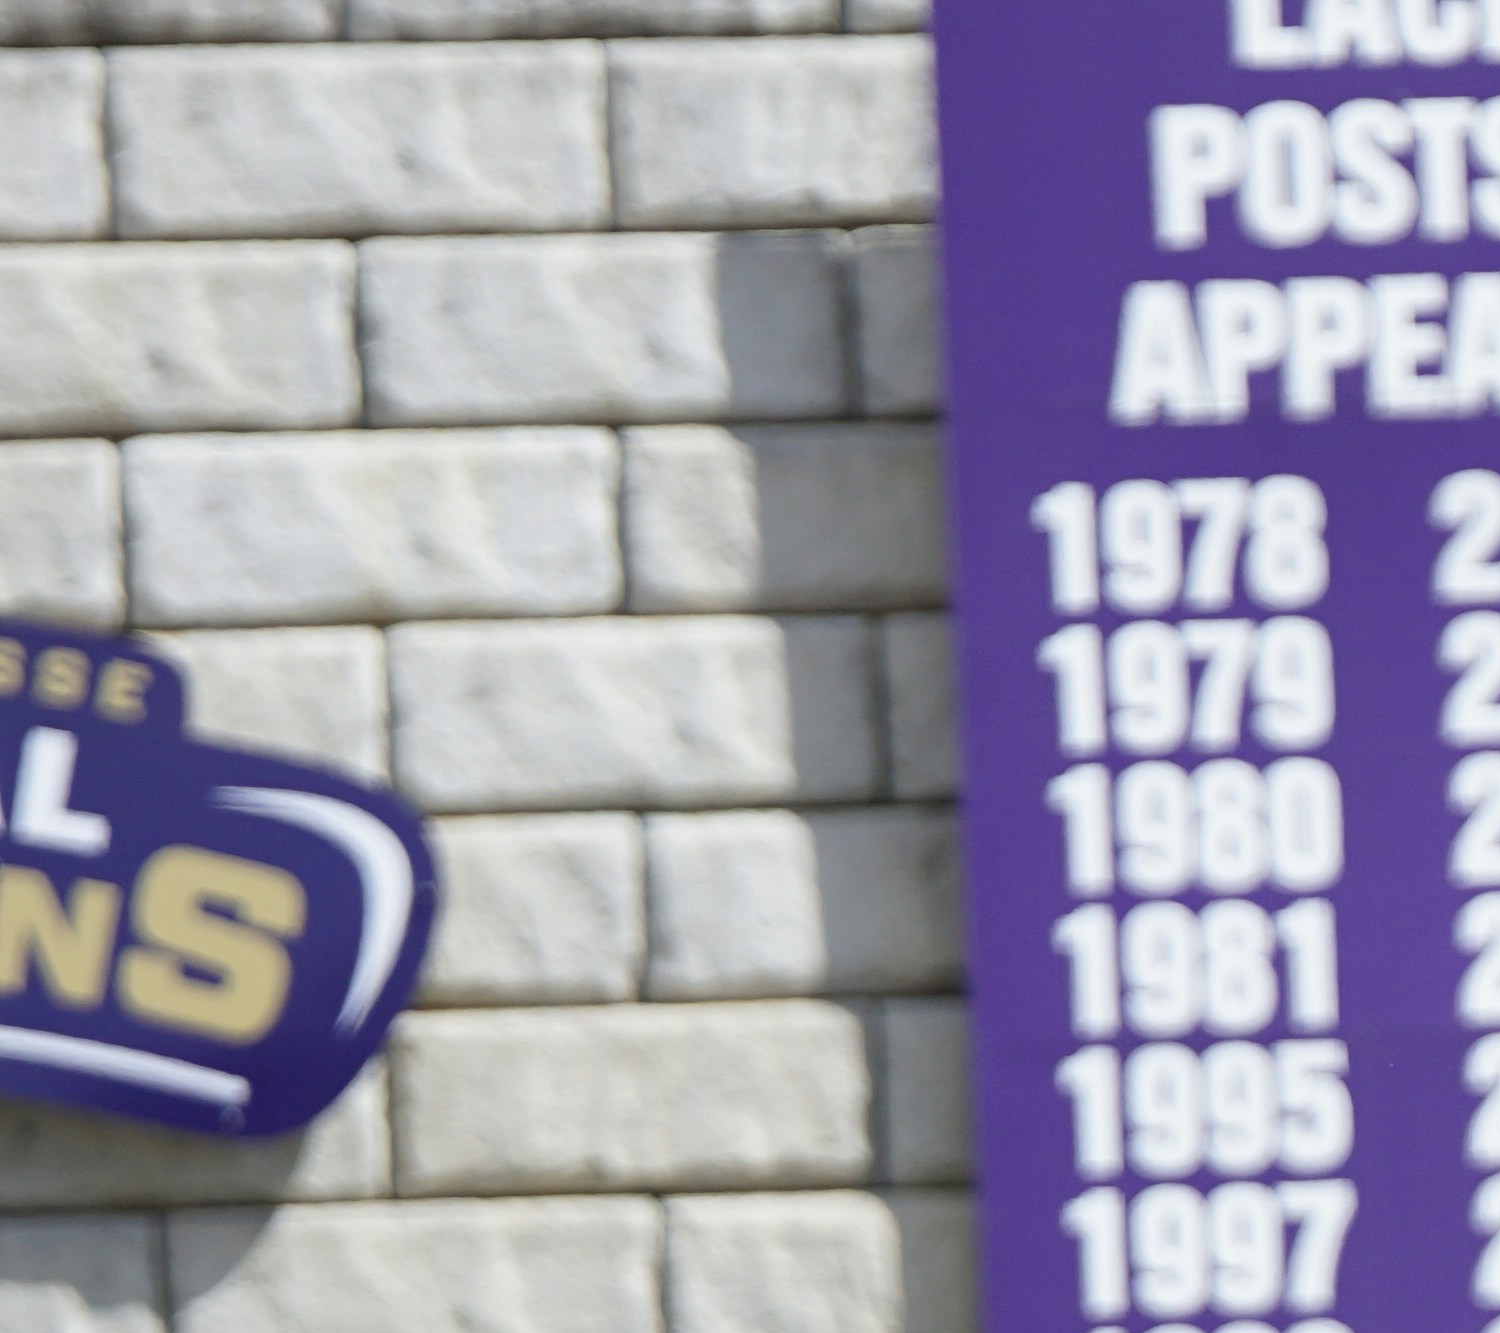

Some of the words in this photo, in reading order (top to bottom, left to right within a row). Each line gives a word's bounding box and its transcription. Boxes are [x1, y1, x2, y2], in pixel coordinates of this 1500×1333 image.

[1033, 475, 1329, 613] 1978
[1039, 616, 1335, 755] 1979
[0, 725, 112, 858] L
[1048, 757, 1344, 897] 1980
[1054, 898, 1339, 1038] 1981
[1057, 1039, 1354, 1178] 1995
[1062, 1179, 1358, 1319] 1997
